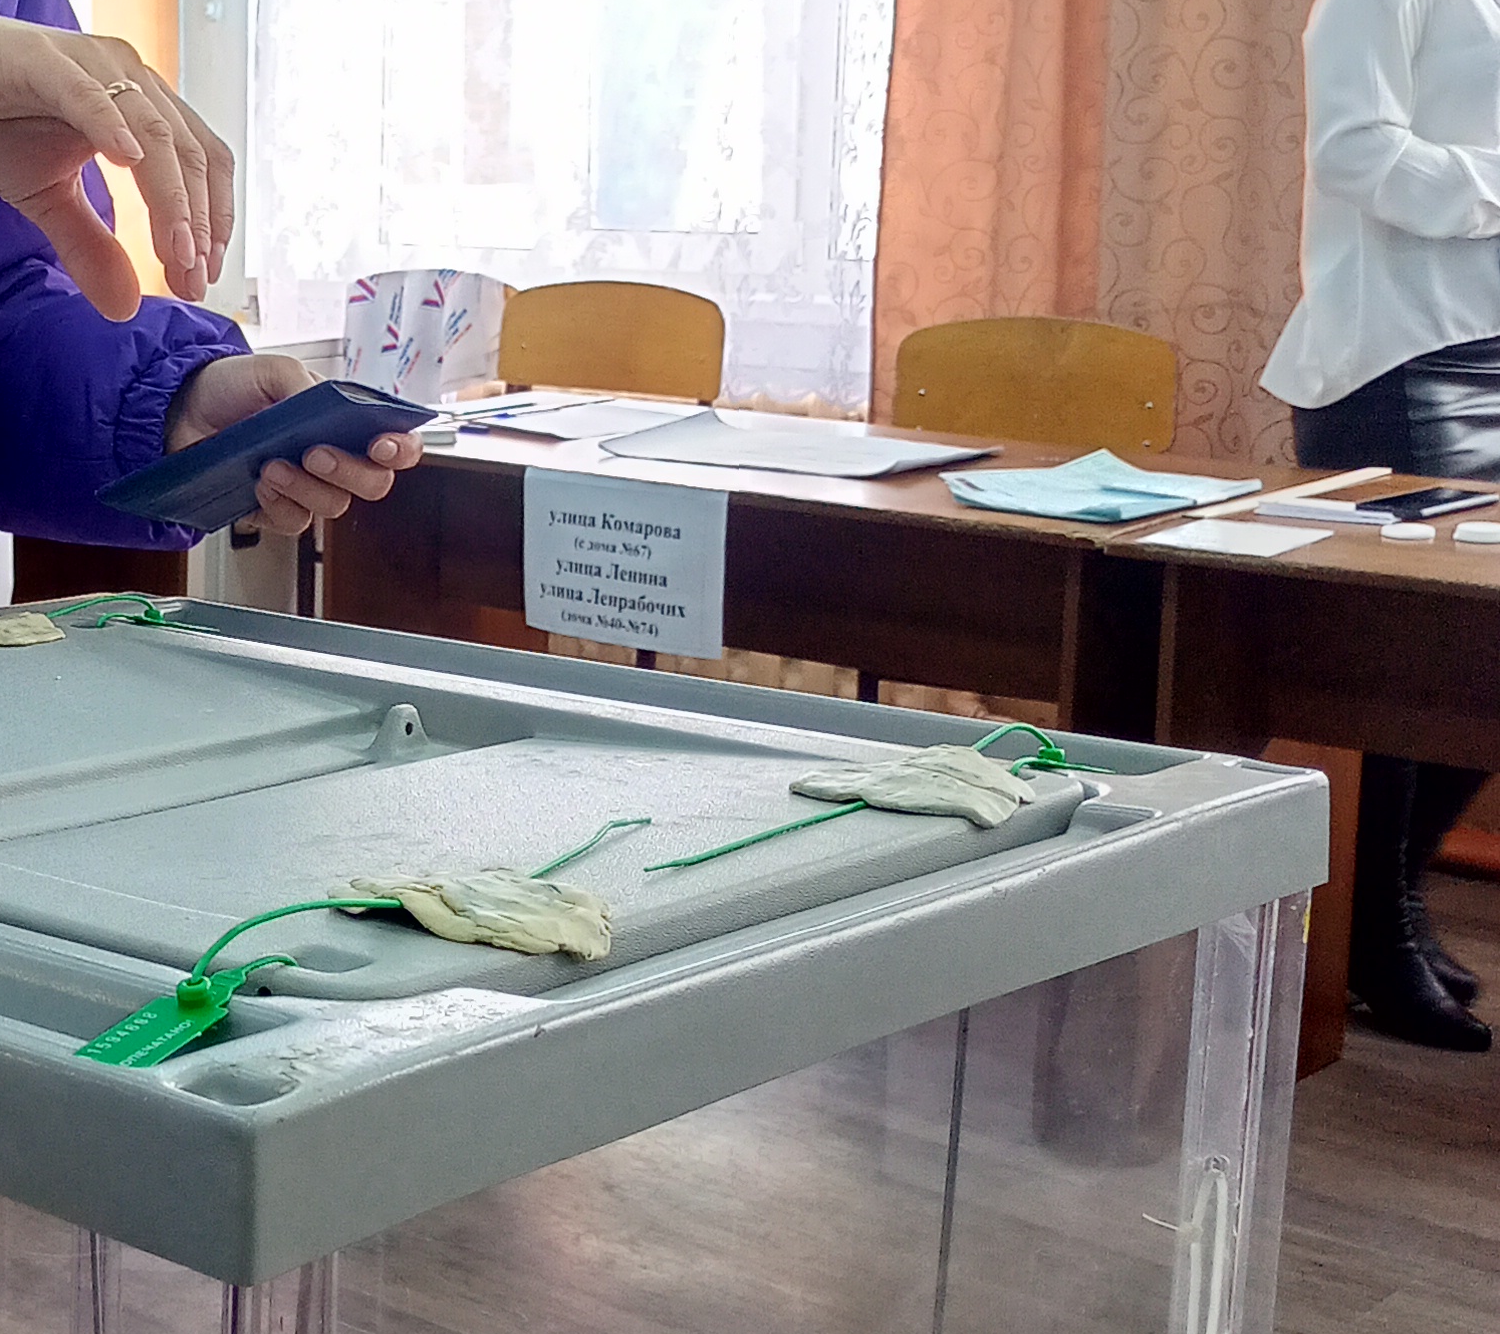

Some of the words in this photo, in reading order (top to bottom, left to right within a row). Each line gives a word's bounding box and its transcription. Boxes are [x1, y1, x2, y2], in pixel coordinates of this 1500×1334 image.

[549, 509, 596, 528] улица
[602, 512, 681, 540] Комарова
[556, 558, 601, 578] улица
[606, 563, 668, 588] Ленина
[540, 581, 583, 602] улица
[587, 588, 686, 618] Ленрабочих
